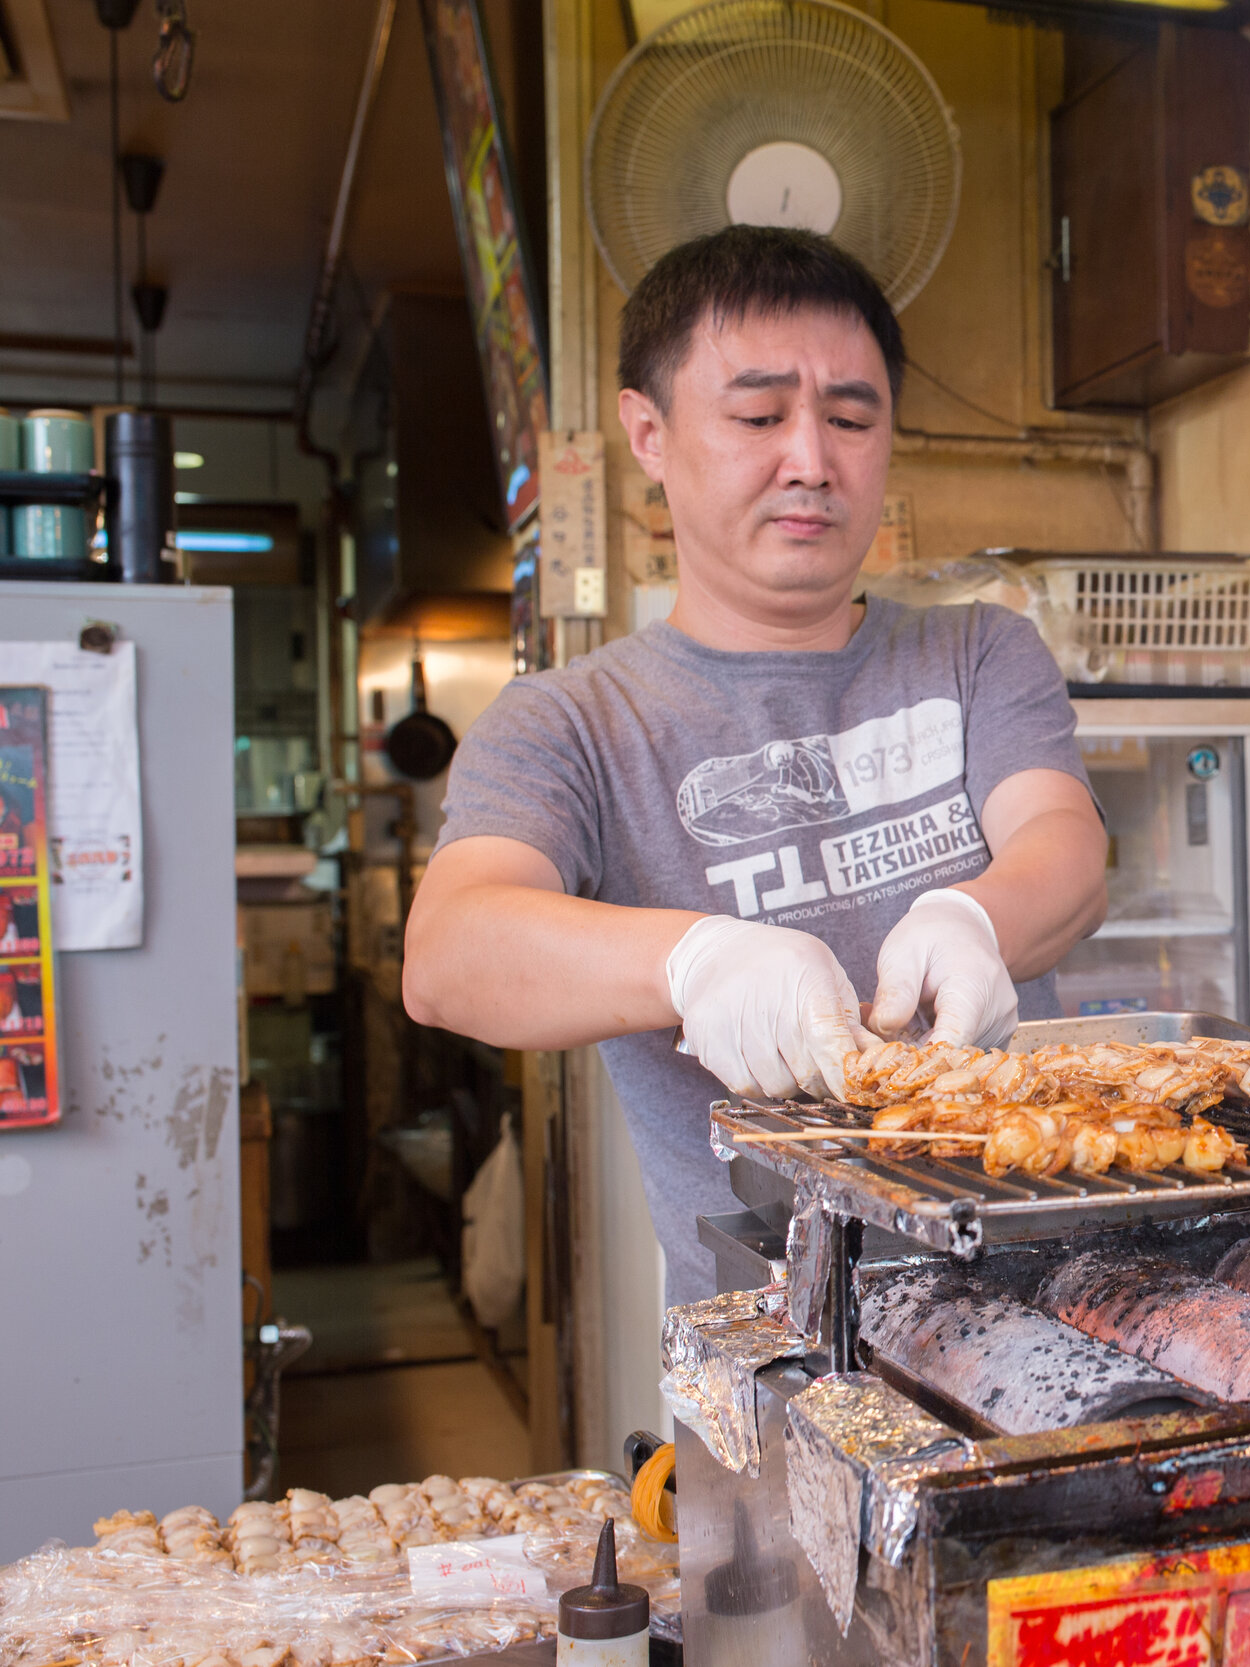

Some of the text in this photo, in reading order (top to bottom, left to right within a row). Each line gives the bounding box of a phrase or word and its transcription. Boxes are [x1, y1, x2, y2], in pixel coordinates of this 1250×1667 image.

[845, 742, 913, 787] 1973
[832, 802, 973, 864] TEZUKA &
[837, 822, 983, 888] TATSUNOKO
